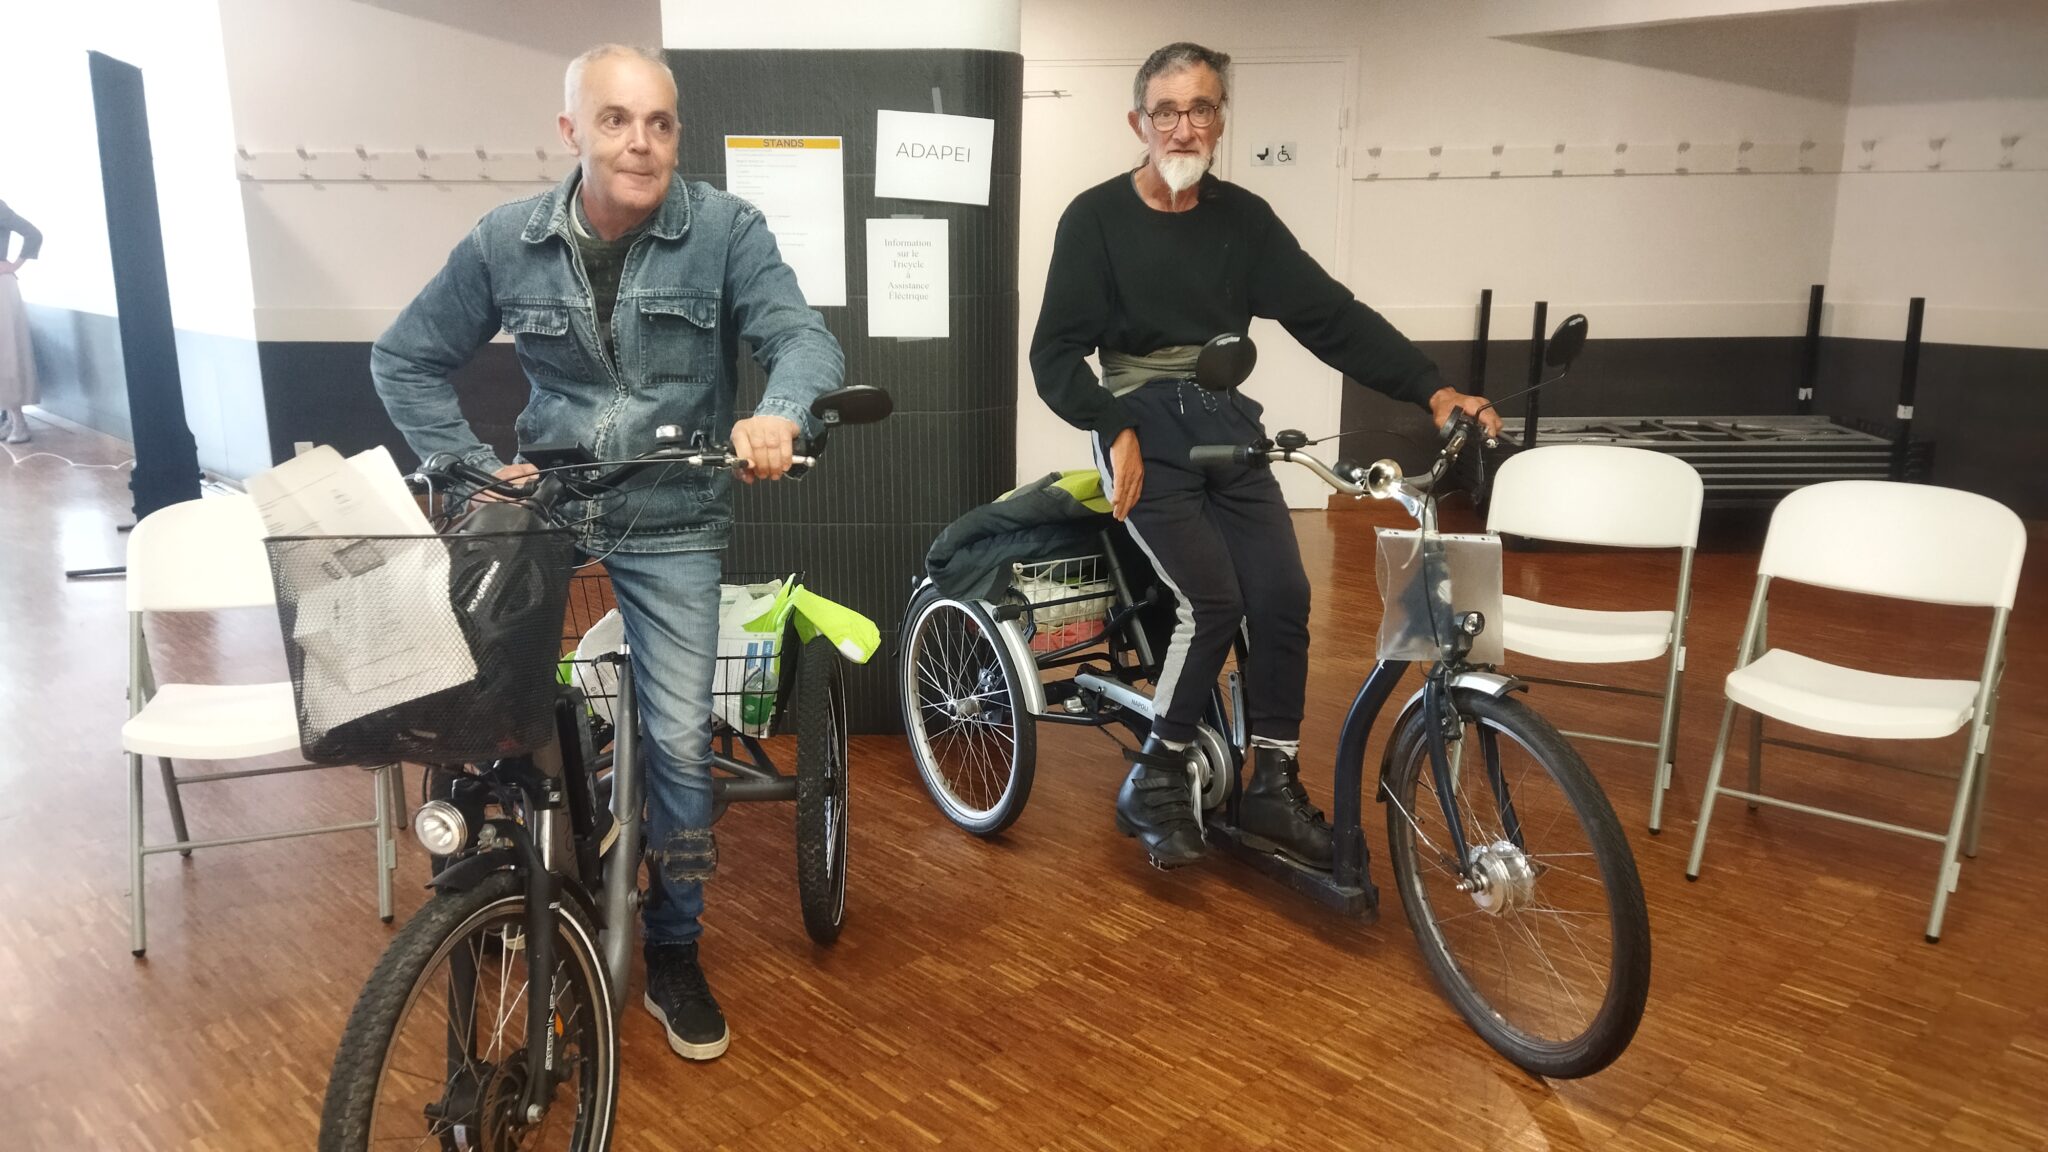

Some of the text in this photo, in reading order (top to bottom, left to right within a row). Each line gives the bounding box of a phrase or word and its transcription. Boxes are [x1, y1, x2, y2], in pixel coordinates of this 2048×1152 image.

[763, 138, 804, 148] STANDS
[896, 141, 971, 163] ADAPEI
[884, 239, 932, 247] Information
[897, 249, 919, 258] sur le
[892, 260, 925, 269] Tricycle
[888, 281, 930, 290] Assistance
